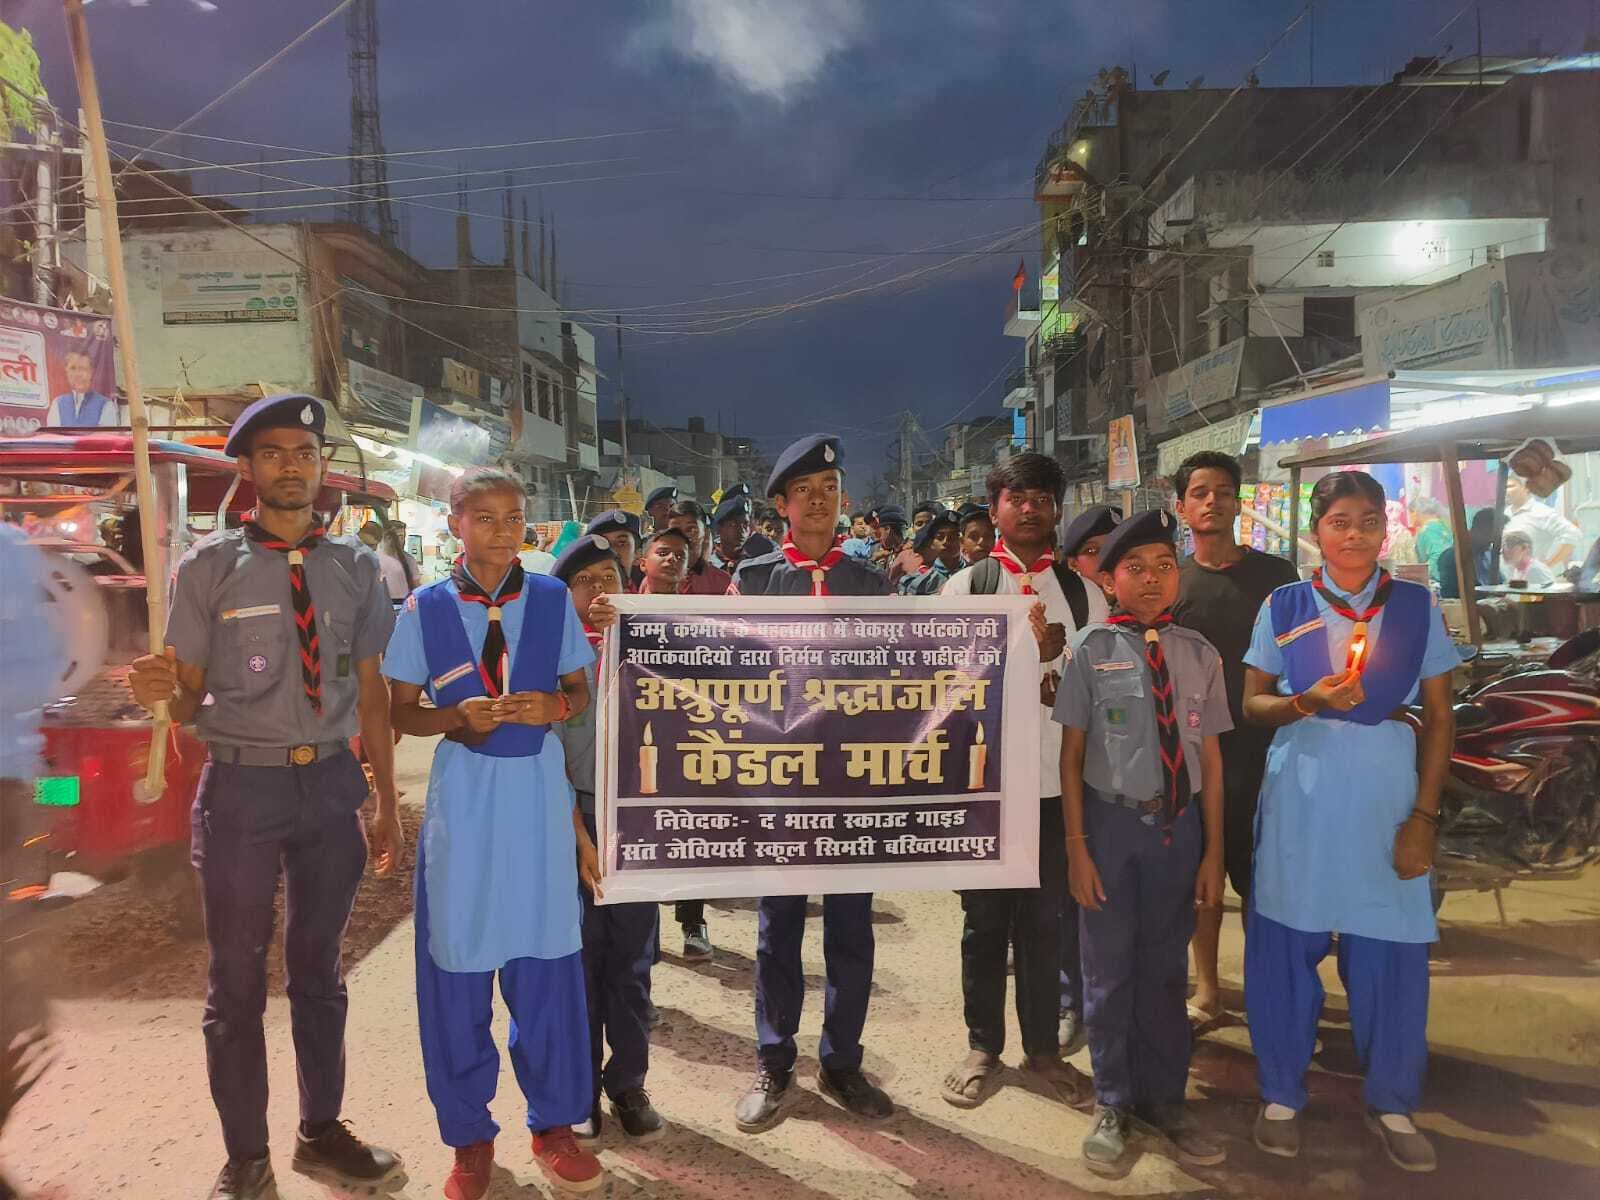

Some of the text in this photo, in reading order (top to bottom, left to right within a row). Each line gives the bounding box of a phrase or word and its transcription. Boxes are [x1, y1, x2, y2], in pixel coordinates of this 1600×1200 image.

[628, 621, 669, 643] जम्मू
[673, 618, 728, 638] कश्मीर
[734, 617, 750, 638] के
[832, 618, 851, 638] में
[854, 618, 905, 643] बेकसूर
[911, 617, 971, 638] पर्यटकों
[975, 618, 999, 638] की
[626, 645, 1002, 667] आतंकवादियों द्वारा निर्मम हत्याओं पर शहीदों को
[635, 668, 991, 724] अश्रुपूर्ण श्रद्धांजलि
[676, 729, 950, 786] कैंडल मार्च
[759, 813, 776, 830] द
[785, 813, 836, 830] भारत
[843, 812, 909, 829] स्काउट
[915, 809, 967, 828] गाइड
[621, 839, 659, 861] संत
[665, 837, 747, 860] जेवियर्स
[754, 840, 808, 863] स्कूल
[814, 836, 877, 857] सिमरी
